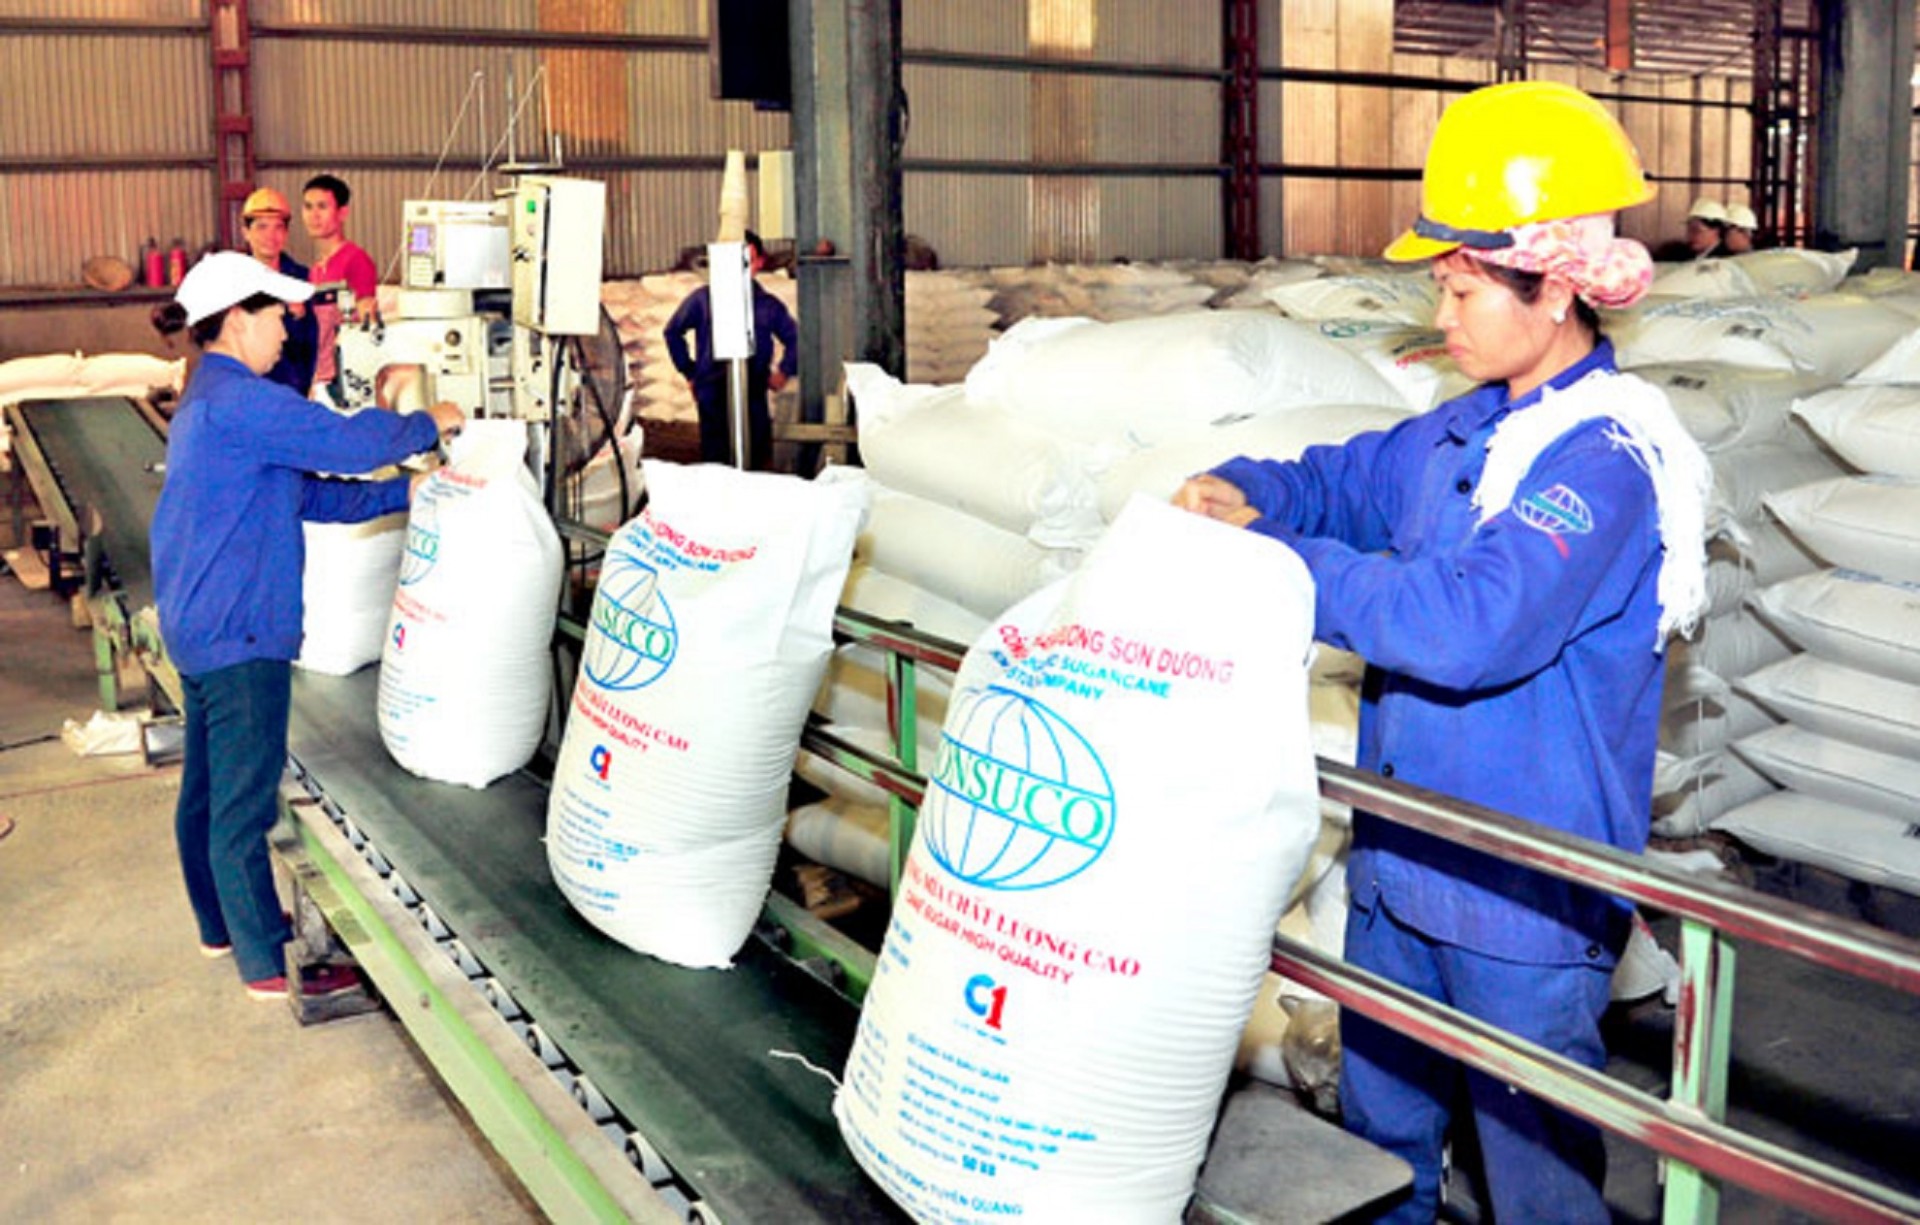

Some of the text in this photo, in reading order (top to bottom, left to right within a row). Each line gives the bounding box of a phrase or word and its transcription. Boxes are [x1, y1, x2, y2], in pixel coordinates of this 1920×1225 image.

[960, 926, 996, 953] HIGH
[996, 943, 1075, 984] QUALITY
[1082, 948, 1142, 977] CAO
[964, 973, 1007, 1031] C1
